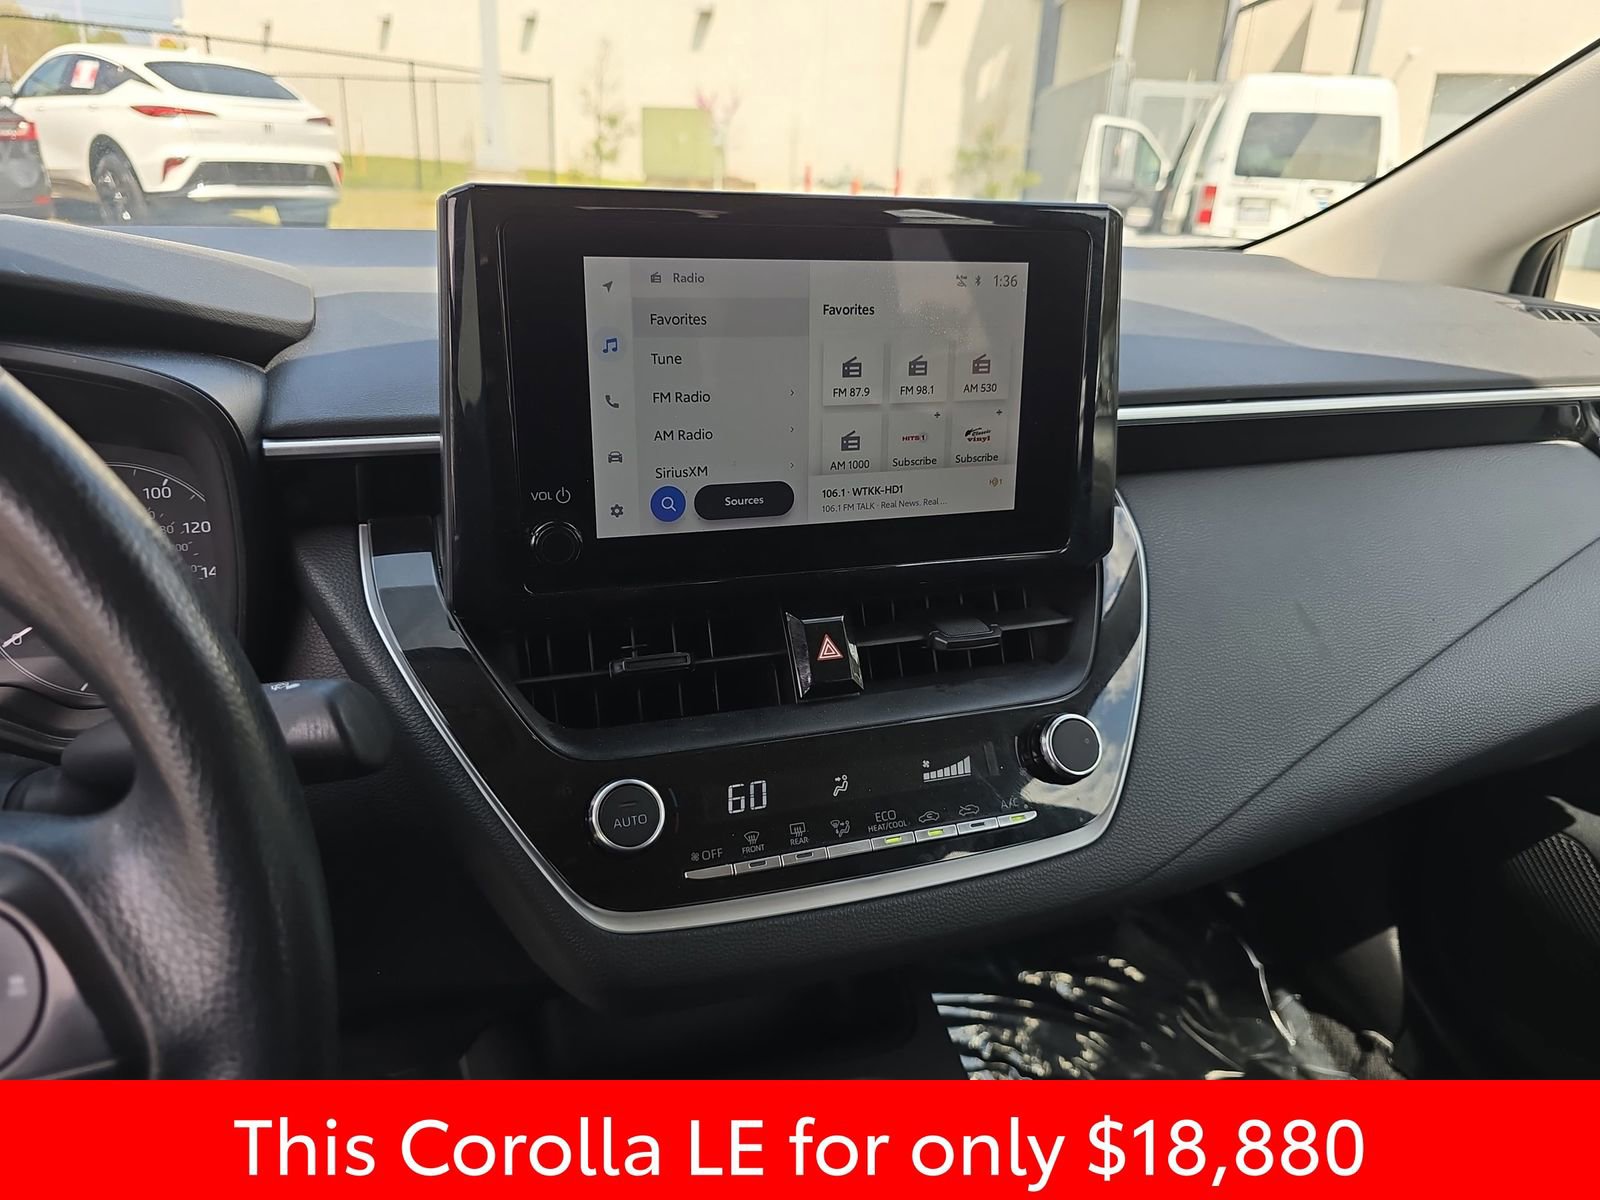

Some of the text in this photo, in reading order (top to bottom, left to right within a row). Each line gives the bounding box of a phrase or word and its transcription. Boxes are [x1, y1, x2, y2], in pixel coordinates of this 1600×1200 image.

[673, 272, 705, 284] Radio
[993, 274, 1018, 288] 1:36
[823, 303, 875, 316] Favorites
[650, 313, 707, 326] Favorites
[651, 353, 682, 365] Tune
[833, 387, 870, 397] FM 87.9
[900, 385, 934, 395] FM 98.1
[963, 383, 997, 393] AM 530
[653, 390, 711, 403] FM Radio
[654, 429, 713, 441] AM Radio
[892, 456, 937, 467] Subscribe
[955, 453, 999, 464] Subscribe
[830, 460, 870, 470] AM 1000
[655, 466, 708, 479] SiriusXM
[142, 486, 172, 500] 100
[530, 491, 553, 501] VOL
[822, 485, 904, 498] 106.1 WTKK-HD1
[725, 496, 764, 506] Sources
[822, 505, 841, 513] 106.1
[843, 503, 855, 511] FM
[857, 502, 875, 510] TALK
[881, 501, 897, 509] Real
[923, 498, 939, 506] Real
[182, 521, 211, 534] 120
[728, 780, 767, 814] 60
[613, 813, 648, 829] AUTO
[875, 810, 897, 822] ECO
[867, 820, 908, 833] HEAT/COOL
[790, 837, 809, 846] REAR
[702, 848, 723, 861] OFF
[741, 843, 765, 855] FRONT
